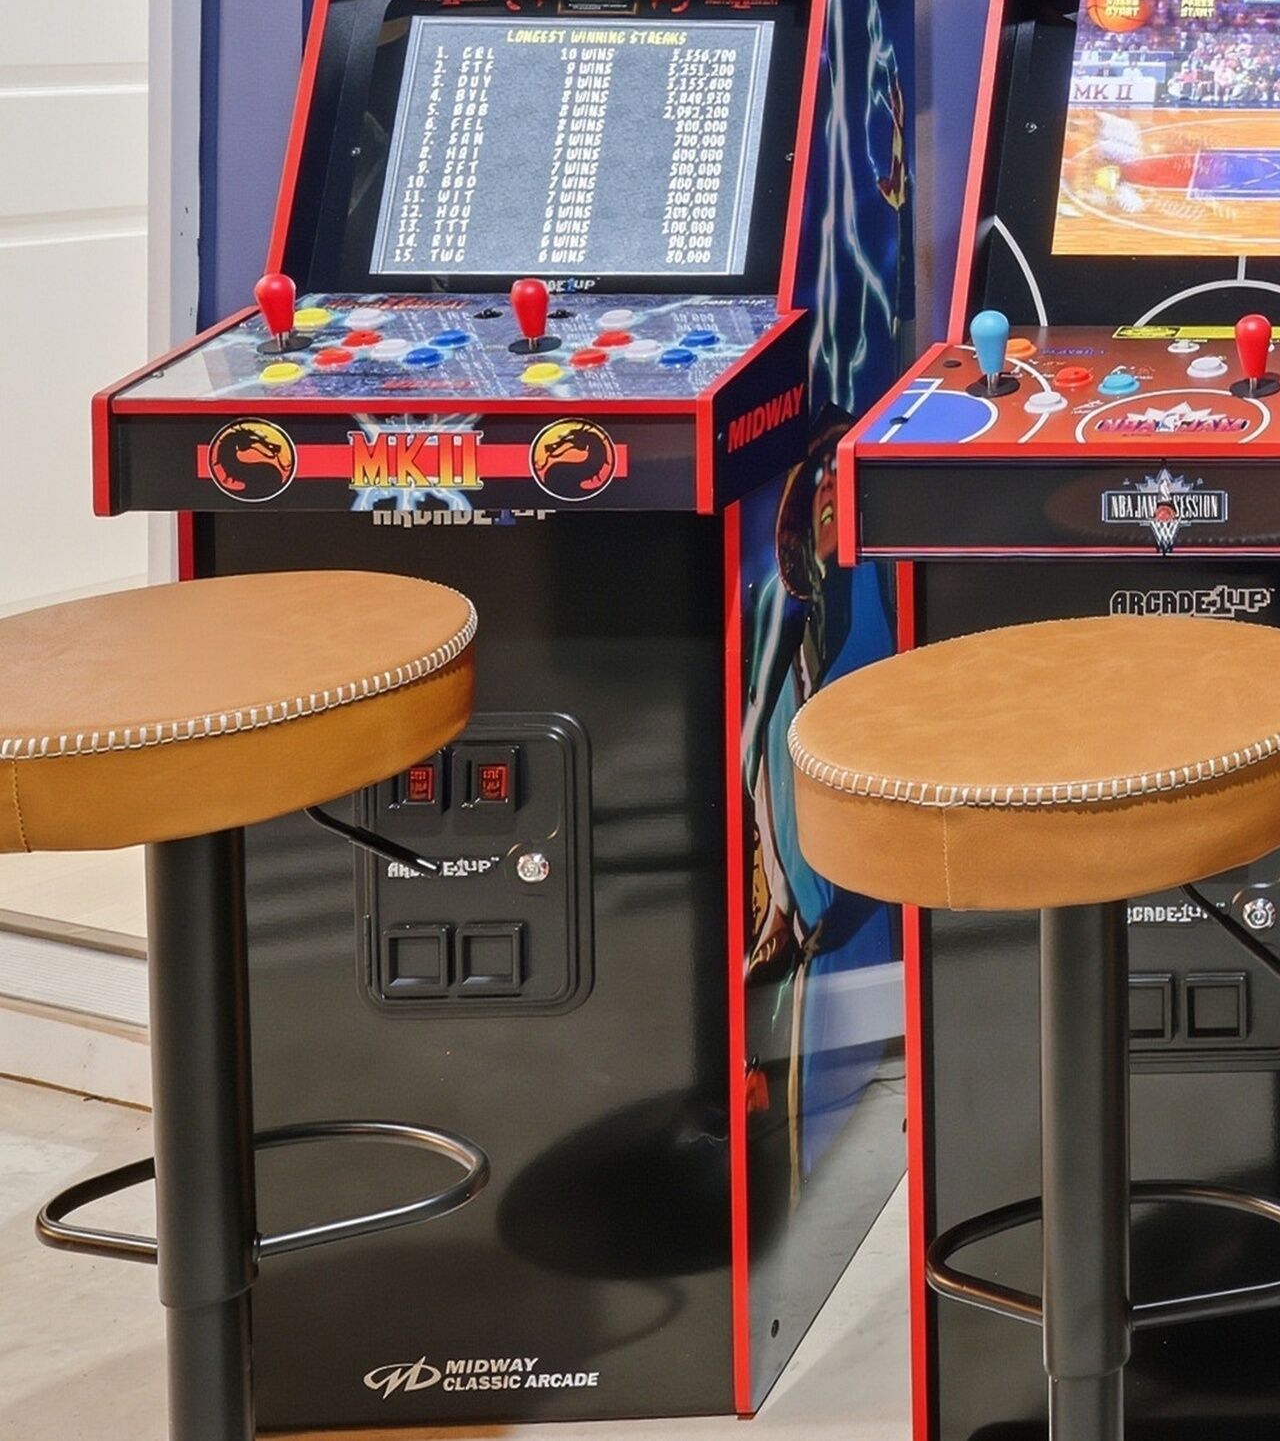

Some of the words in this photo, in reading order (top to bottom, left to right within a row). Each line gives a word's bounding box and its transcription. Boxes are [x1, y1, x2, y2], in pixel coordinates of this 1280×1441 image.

[507, 30, 566, 44] LONGEST
[571, 31, 626, 44] WINNING
[629, 31, 687, 45] STREAKS
[581, 48, 615, 61] WINS
[579, 62, 614, 75] WINS
[577, 77, 611, 89] WINS
[574, 91, 610, 103] WINS
[1073, 83, 1109, 100] MK
[1113, 83, 1134, 101] II
[572, 105, 607, 117] WINS
[570, 119, 604, 132] WINS
[568, 133, 602, 147] WINS
[566, 147, 600, 161] WINS
[564, 162, 598, 175] WINS
[562, 176, 596, 189] WINS
[560, 191, 594, 204] WINS
[558, 205, 592, 219] WINS
[556, 220, 590, 233] WINS
[553, 235, 588, 249] WINS
[551, 249, 586, 263] WINS
[727, 383, 804, 454] MIDWAY
[349, 431, 484, 490] MKII
[1111, 495, 1133, 518] NBA
[1173, 494, 1218, 519] SESSION
[446, 1357, 539, 1374] MIDWAY
[443, 1374, 521, 1392] CLASSIC
[524, 1372, 599, 1389] ARCADE
